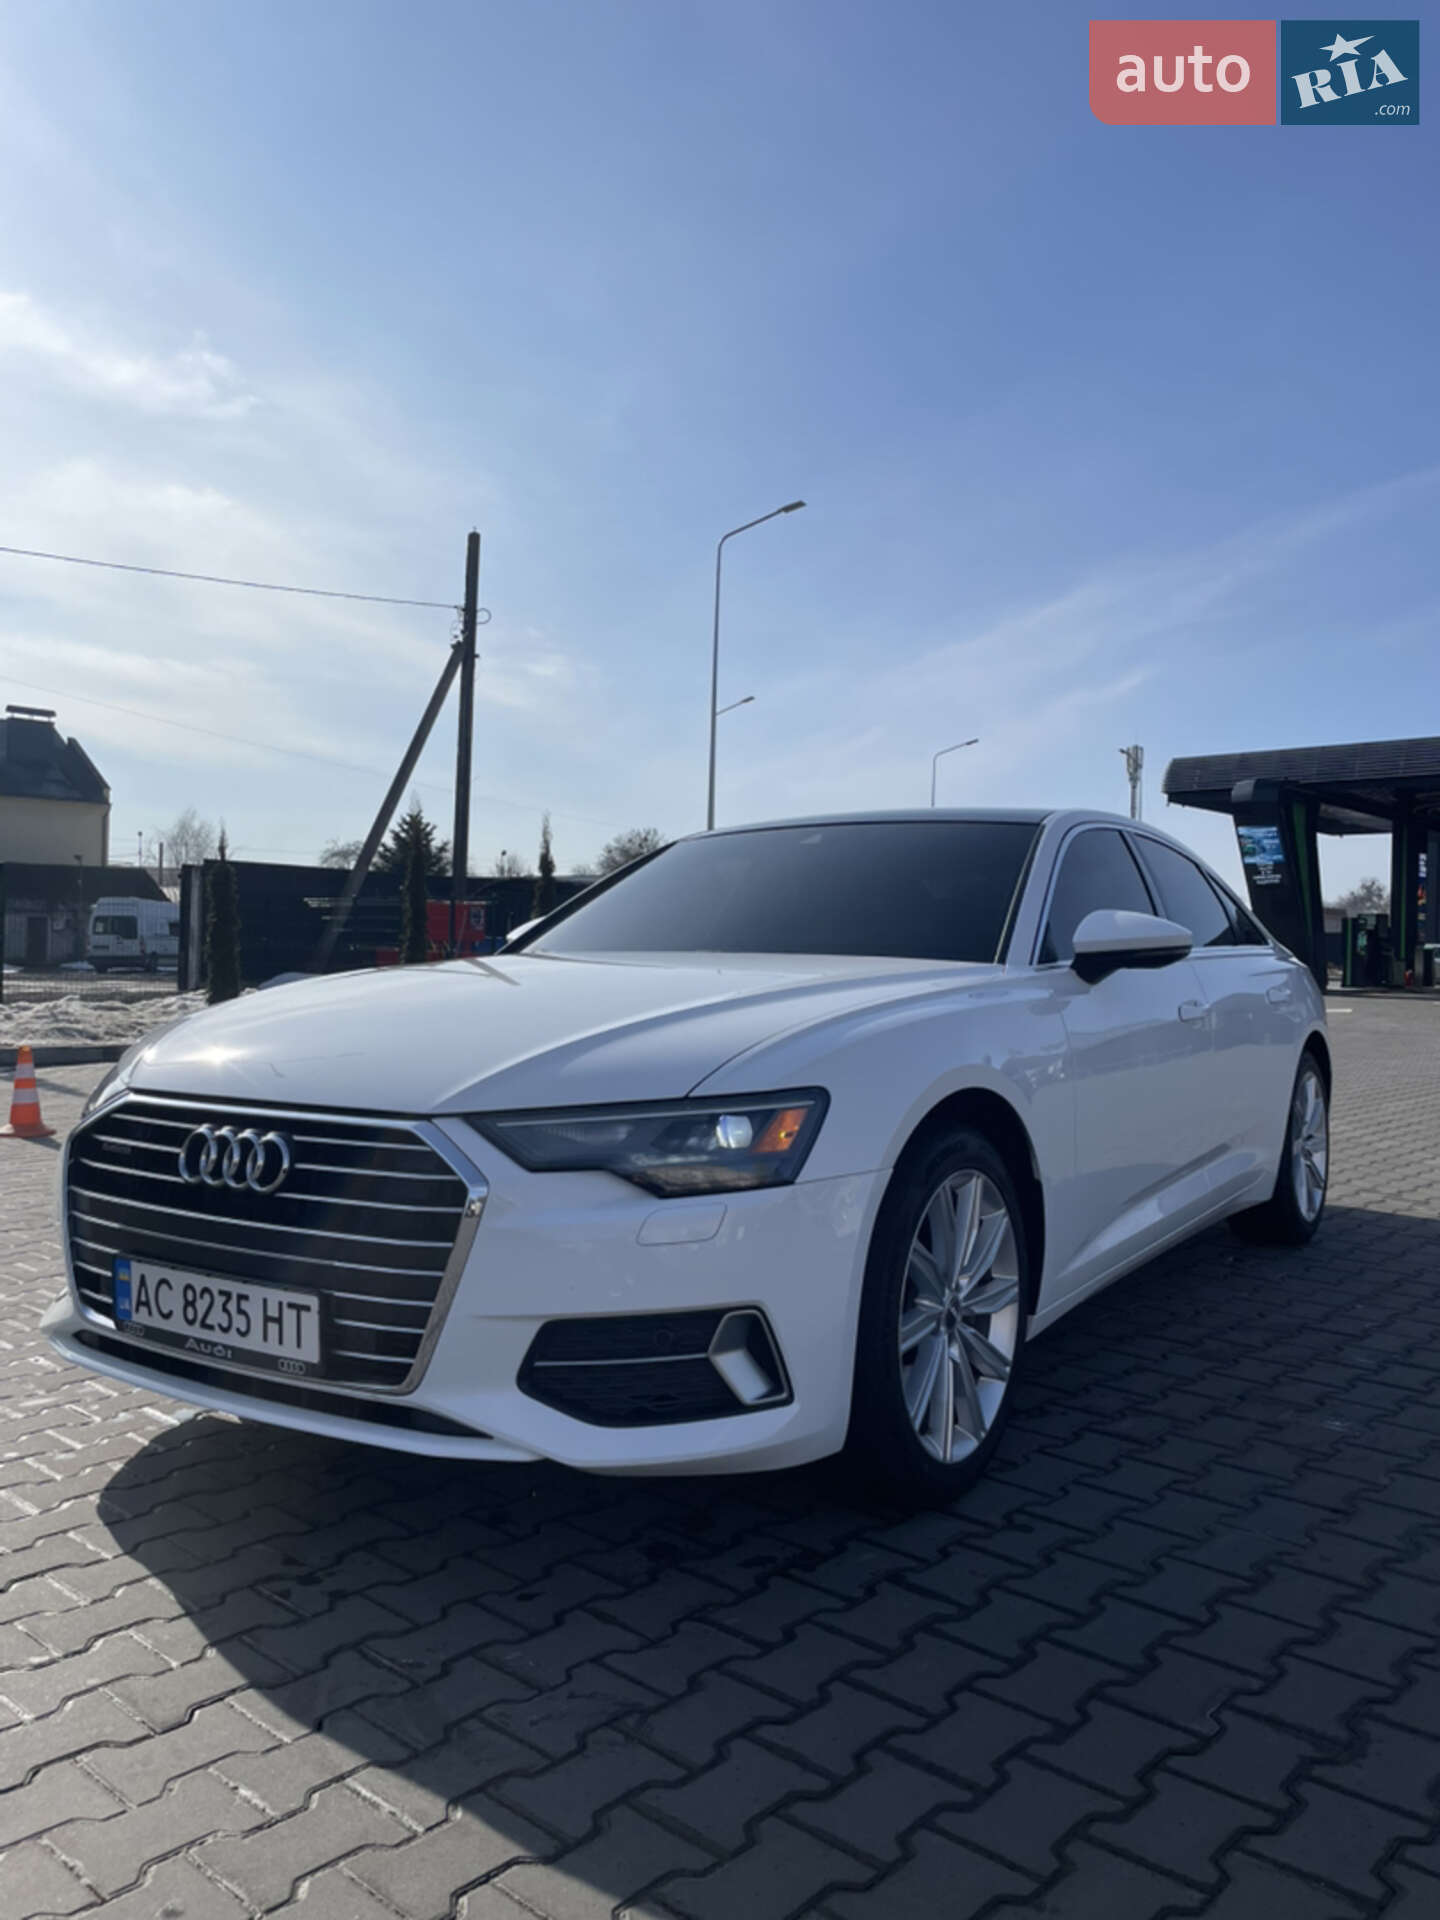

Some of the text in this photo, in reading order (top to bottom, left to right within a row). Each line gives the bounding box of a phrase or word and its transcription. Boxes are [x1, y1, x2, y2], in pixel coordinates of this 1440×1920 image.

[135, 1273, 312, 1349] AC 8235 HT
